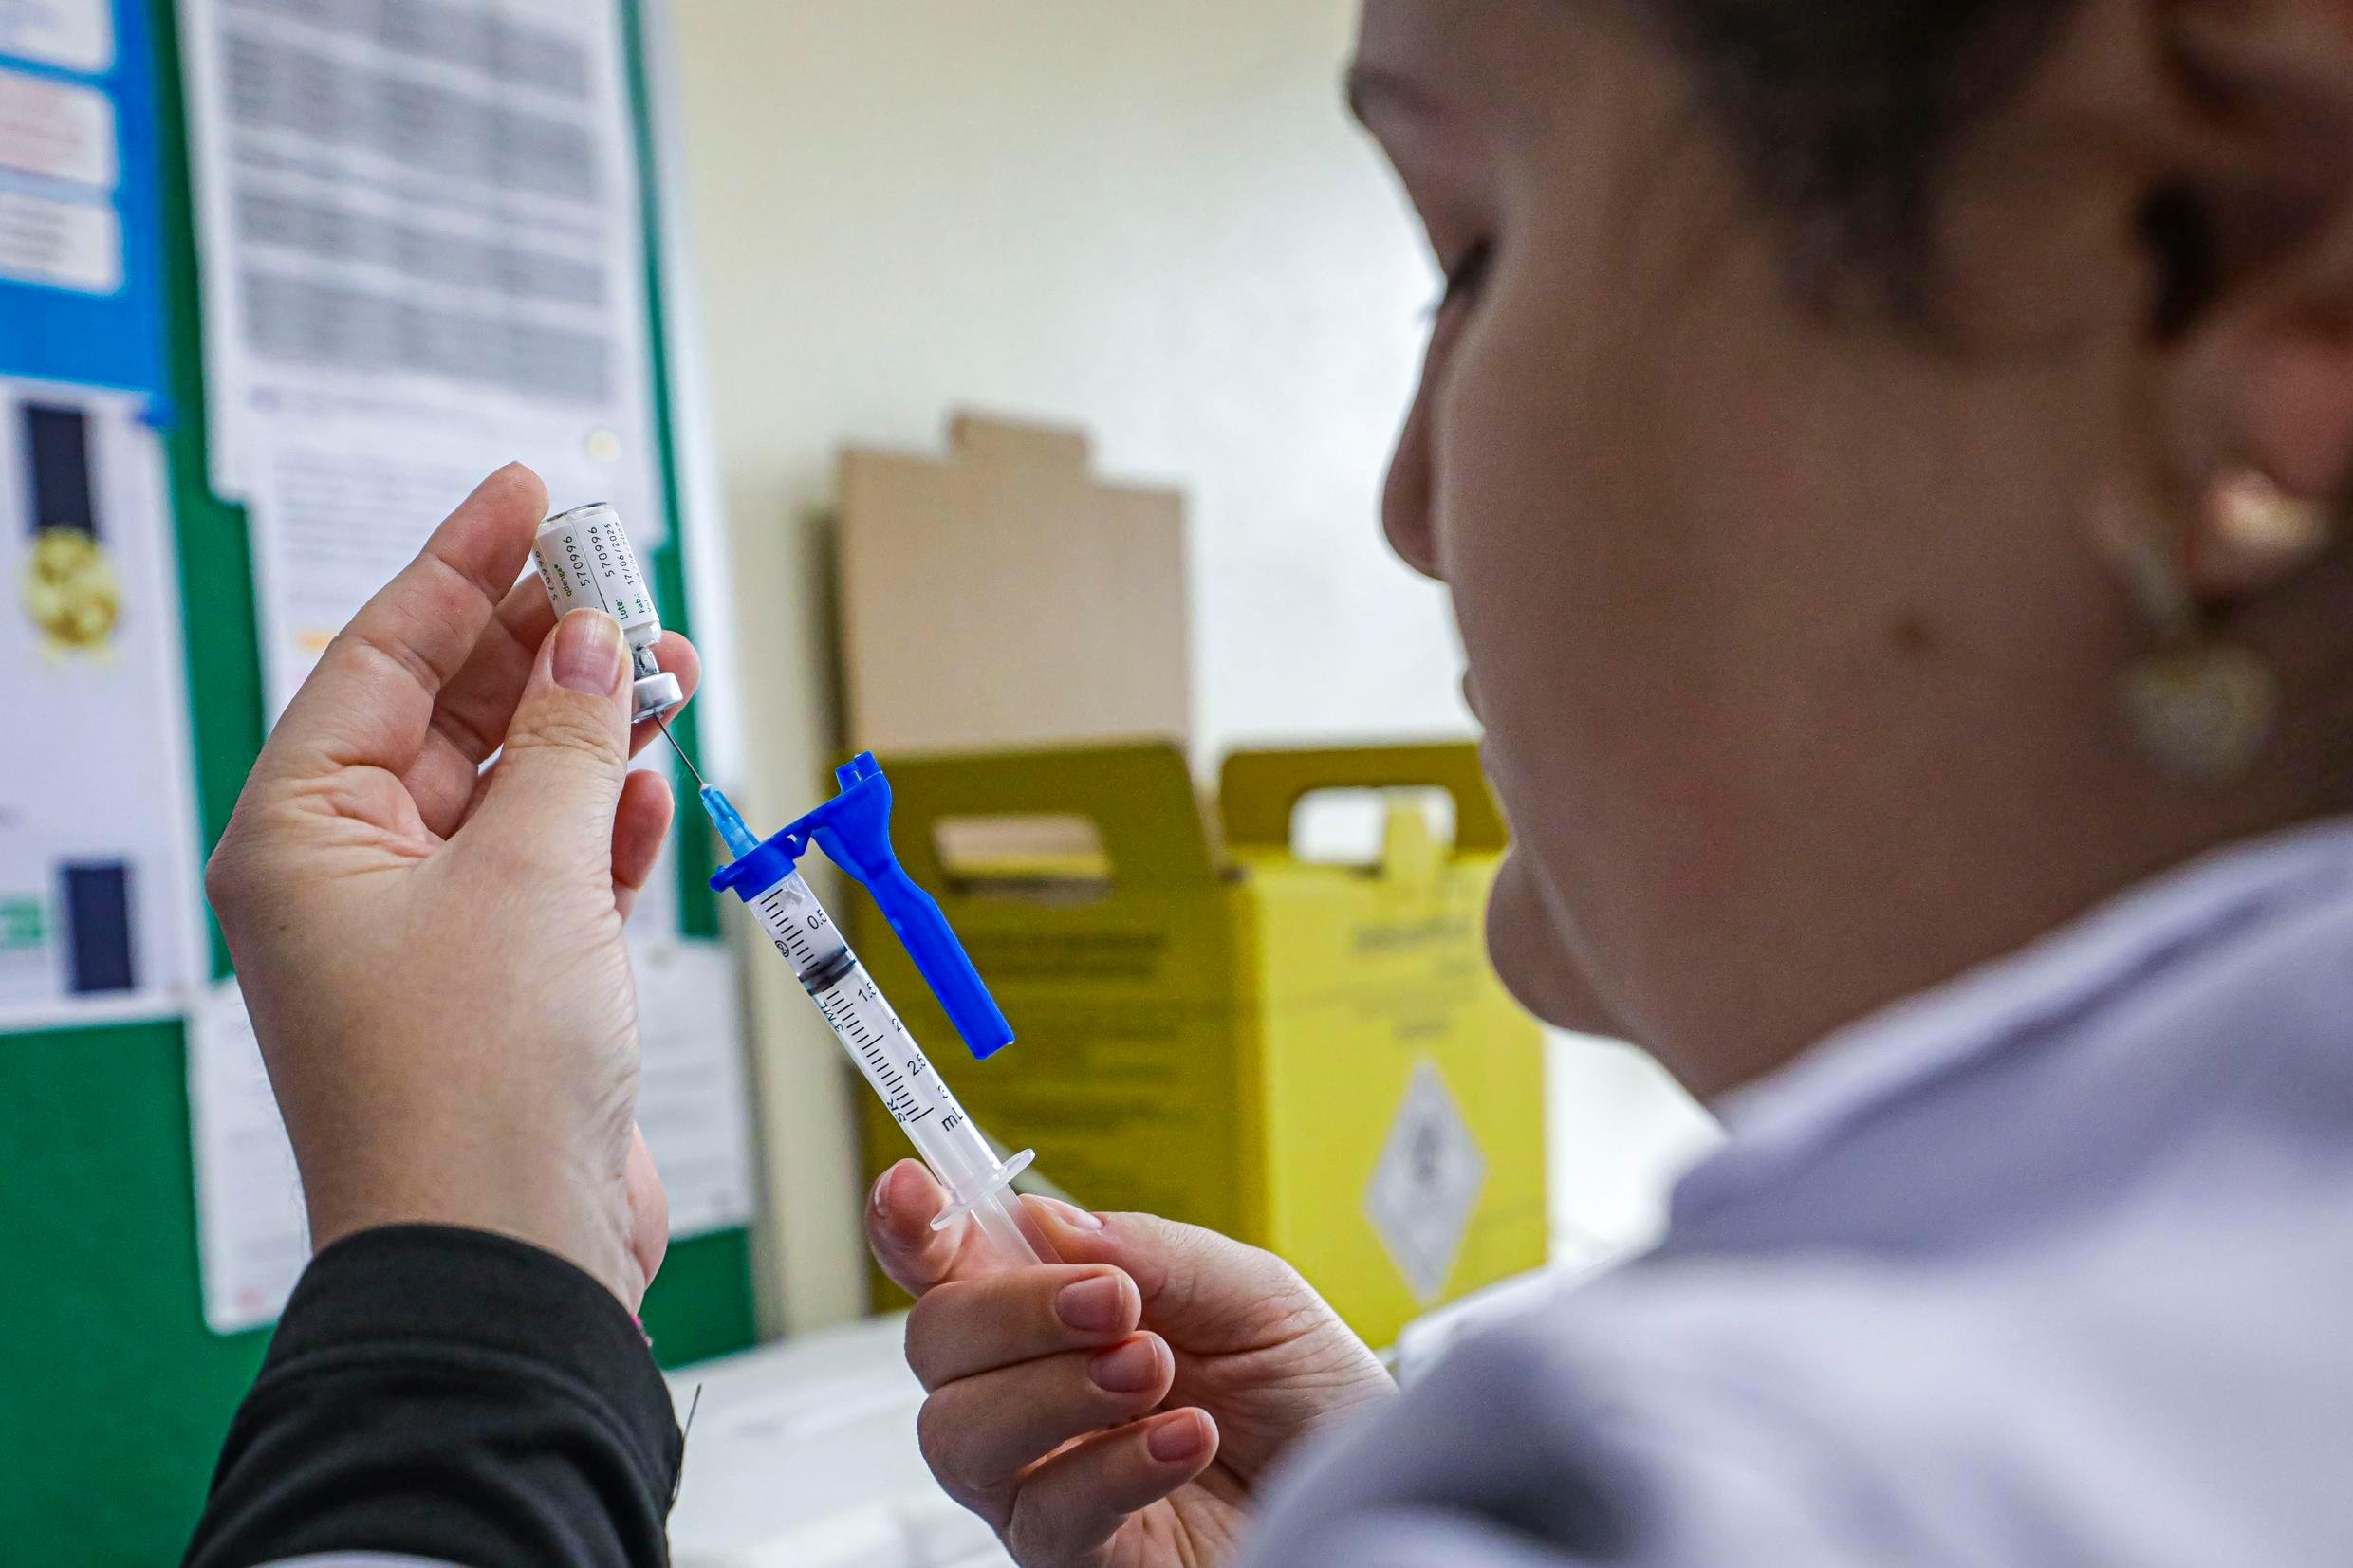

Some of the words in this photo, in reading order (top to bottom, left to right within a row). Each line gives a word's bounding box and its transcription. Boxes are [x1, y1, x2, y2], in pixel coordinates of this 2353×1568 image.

[563, 535, 590, 587] 570996
[587, 526, 615, 578] 570996
[604, 523, 635, 585] 17/06/2025
[806, 908, 827, 930] 0.5
[858, 981, 877, 1002] 1.5
[820, 1001, 837, 1022] ML
[892, 1018, 902, 1032] 2
[907, 1053, 926, 1076] 2.5
[941, 1107, 964, 1132] mL
